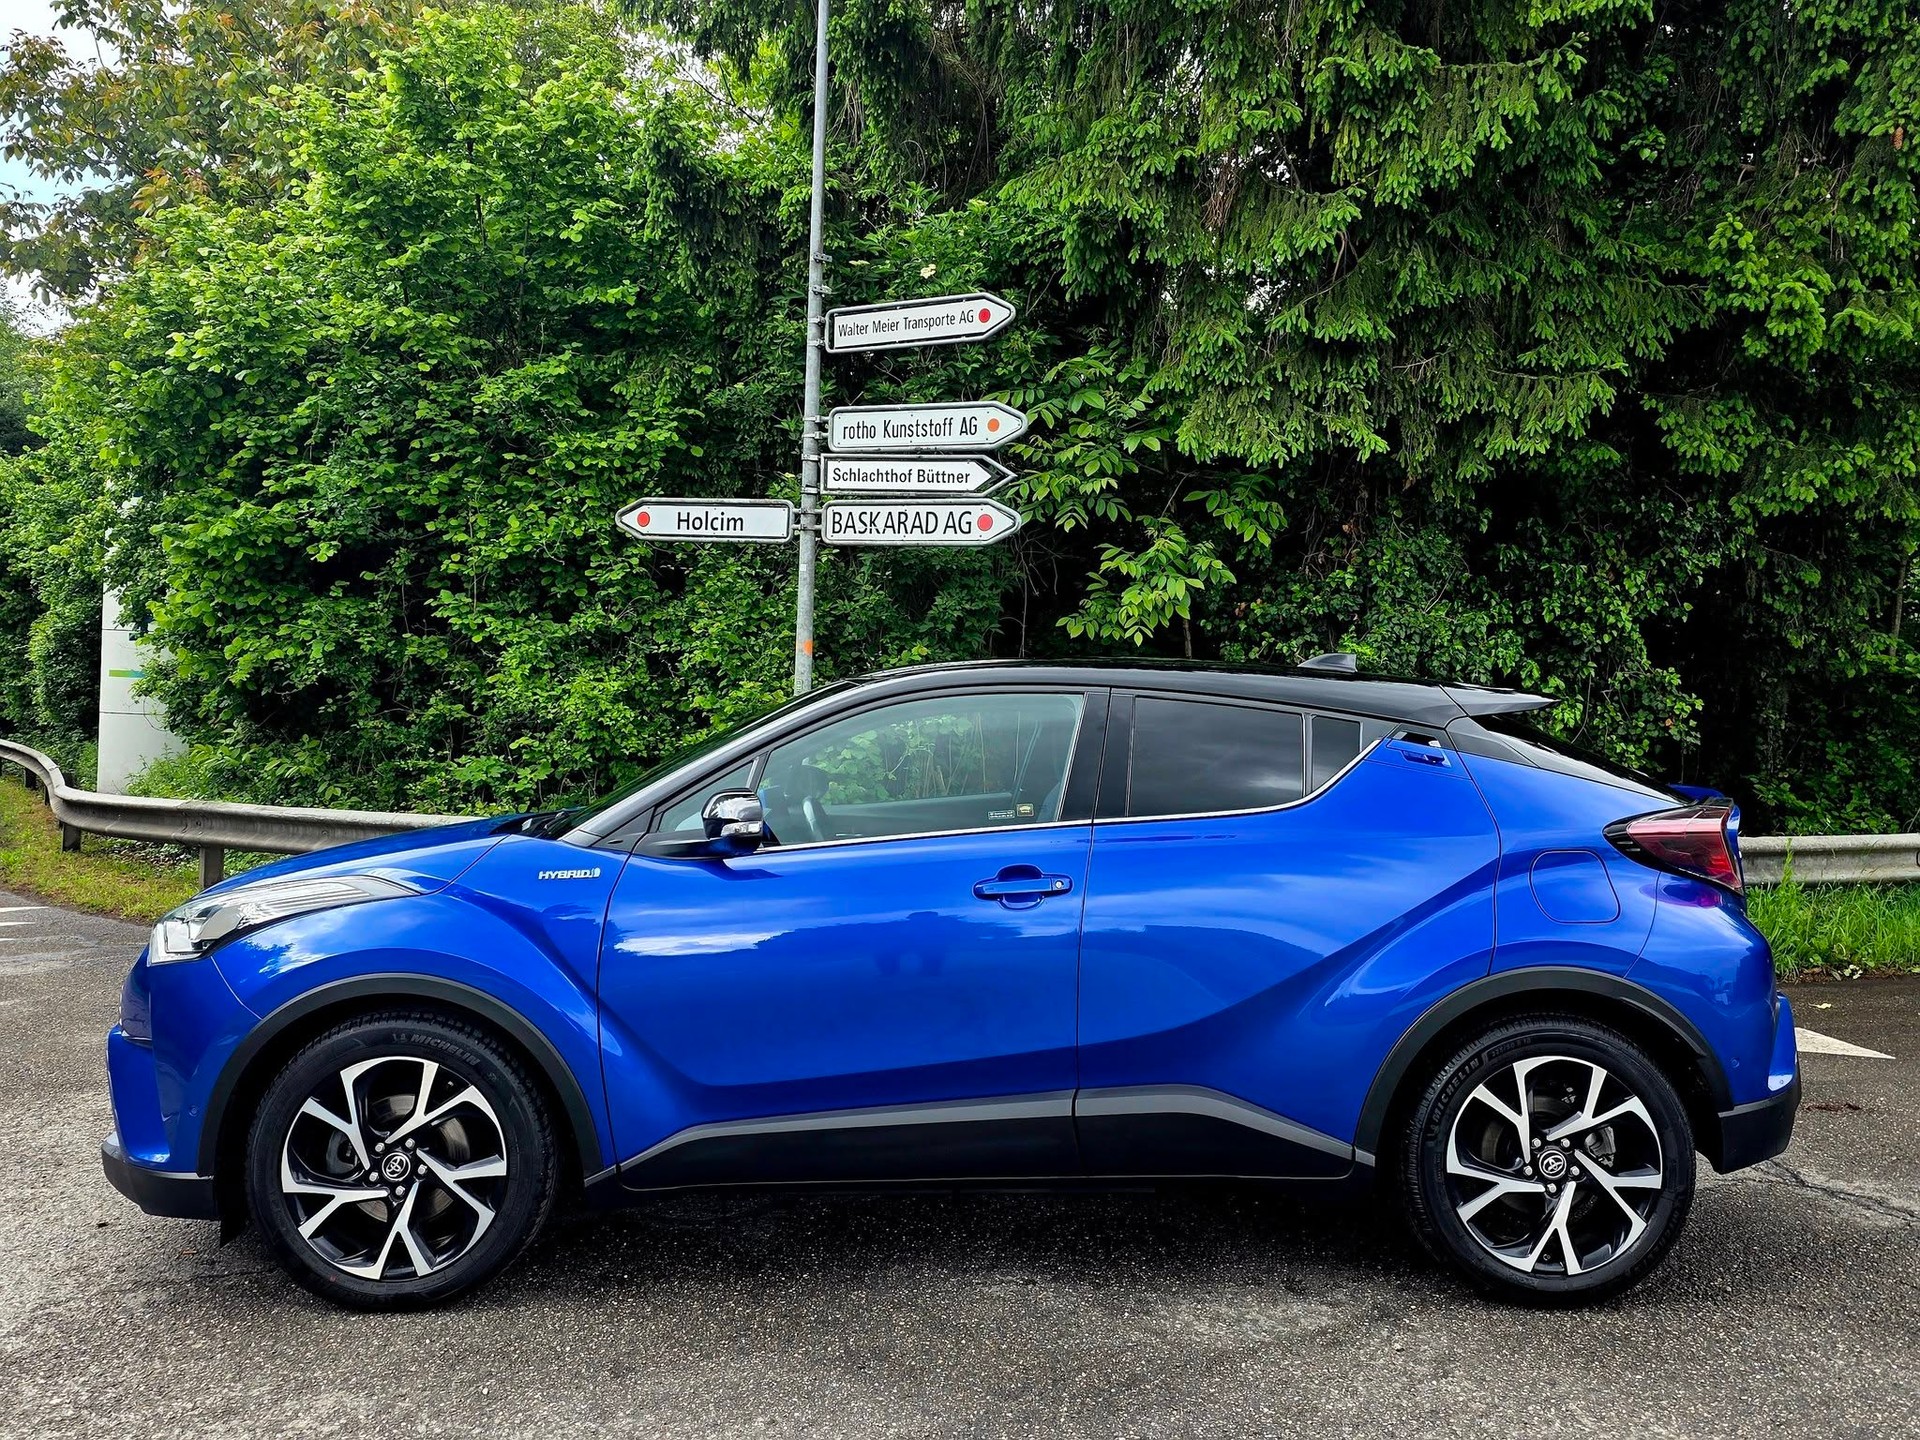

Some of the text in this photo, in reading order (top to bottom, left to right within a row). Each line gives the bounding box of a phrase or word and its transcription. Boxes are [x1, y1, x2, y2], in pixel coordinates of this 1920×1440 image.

[838, 309, 974, 337] Walter Meier Transporte AG
[843, 416, 978, 439] rotho Kunststoff AG
[832, 467, 971, 484] Schlachthof Büttner
[676, 511, 744, 532] Holcim
[831, 511, 972, 535] BASKARAD AG
[538, 869, 593, 880] HYBRID
[410, 1033, 481, 1066] MICHELIN
[1432, 1057, 1480, 1123] MICHELIN
